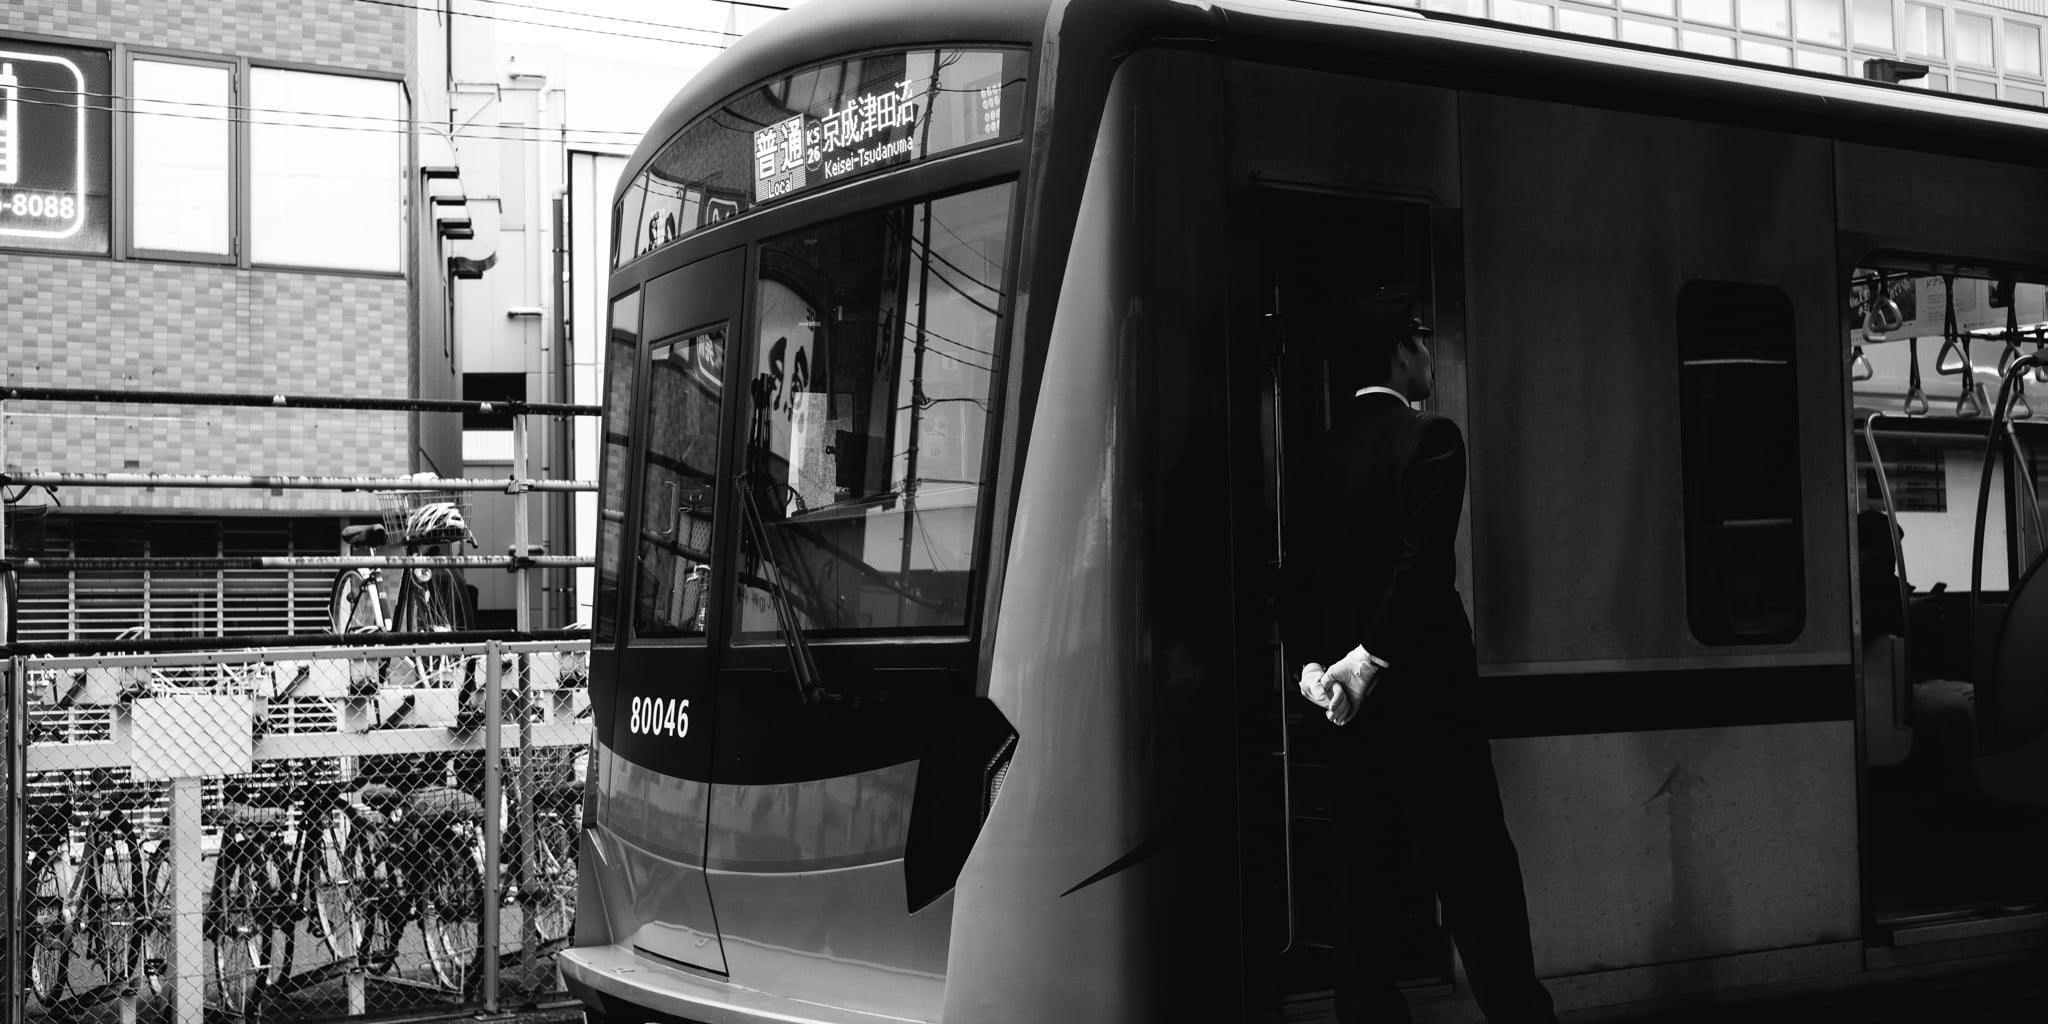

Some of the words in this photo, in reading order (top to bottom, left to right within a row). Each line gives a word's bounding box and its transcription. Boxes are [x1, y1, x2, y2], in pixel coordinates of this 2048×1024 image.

[822, 80, 914, 152] 京成津田沼
[756, 118, 804, 180] 普通
[806, 128, 820, 145] KS
[807, 147, 821, 164] 26
[825, 136, 914, 179] Keisei-Tsudanuma
[768, 172, 793, 198] Local
[0, 193, 74, 219] -8088
[631, 696, 689, 738] 80046
